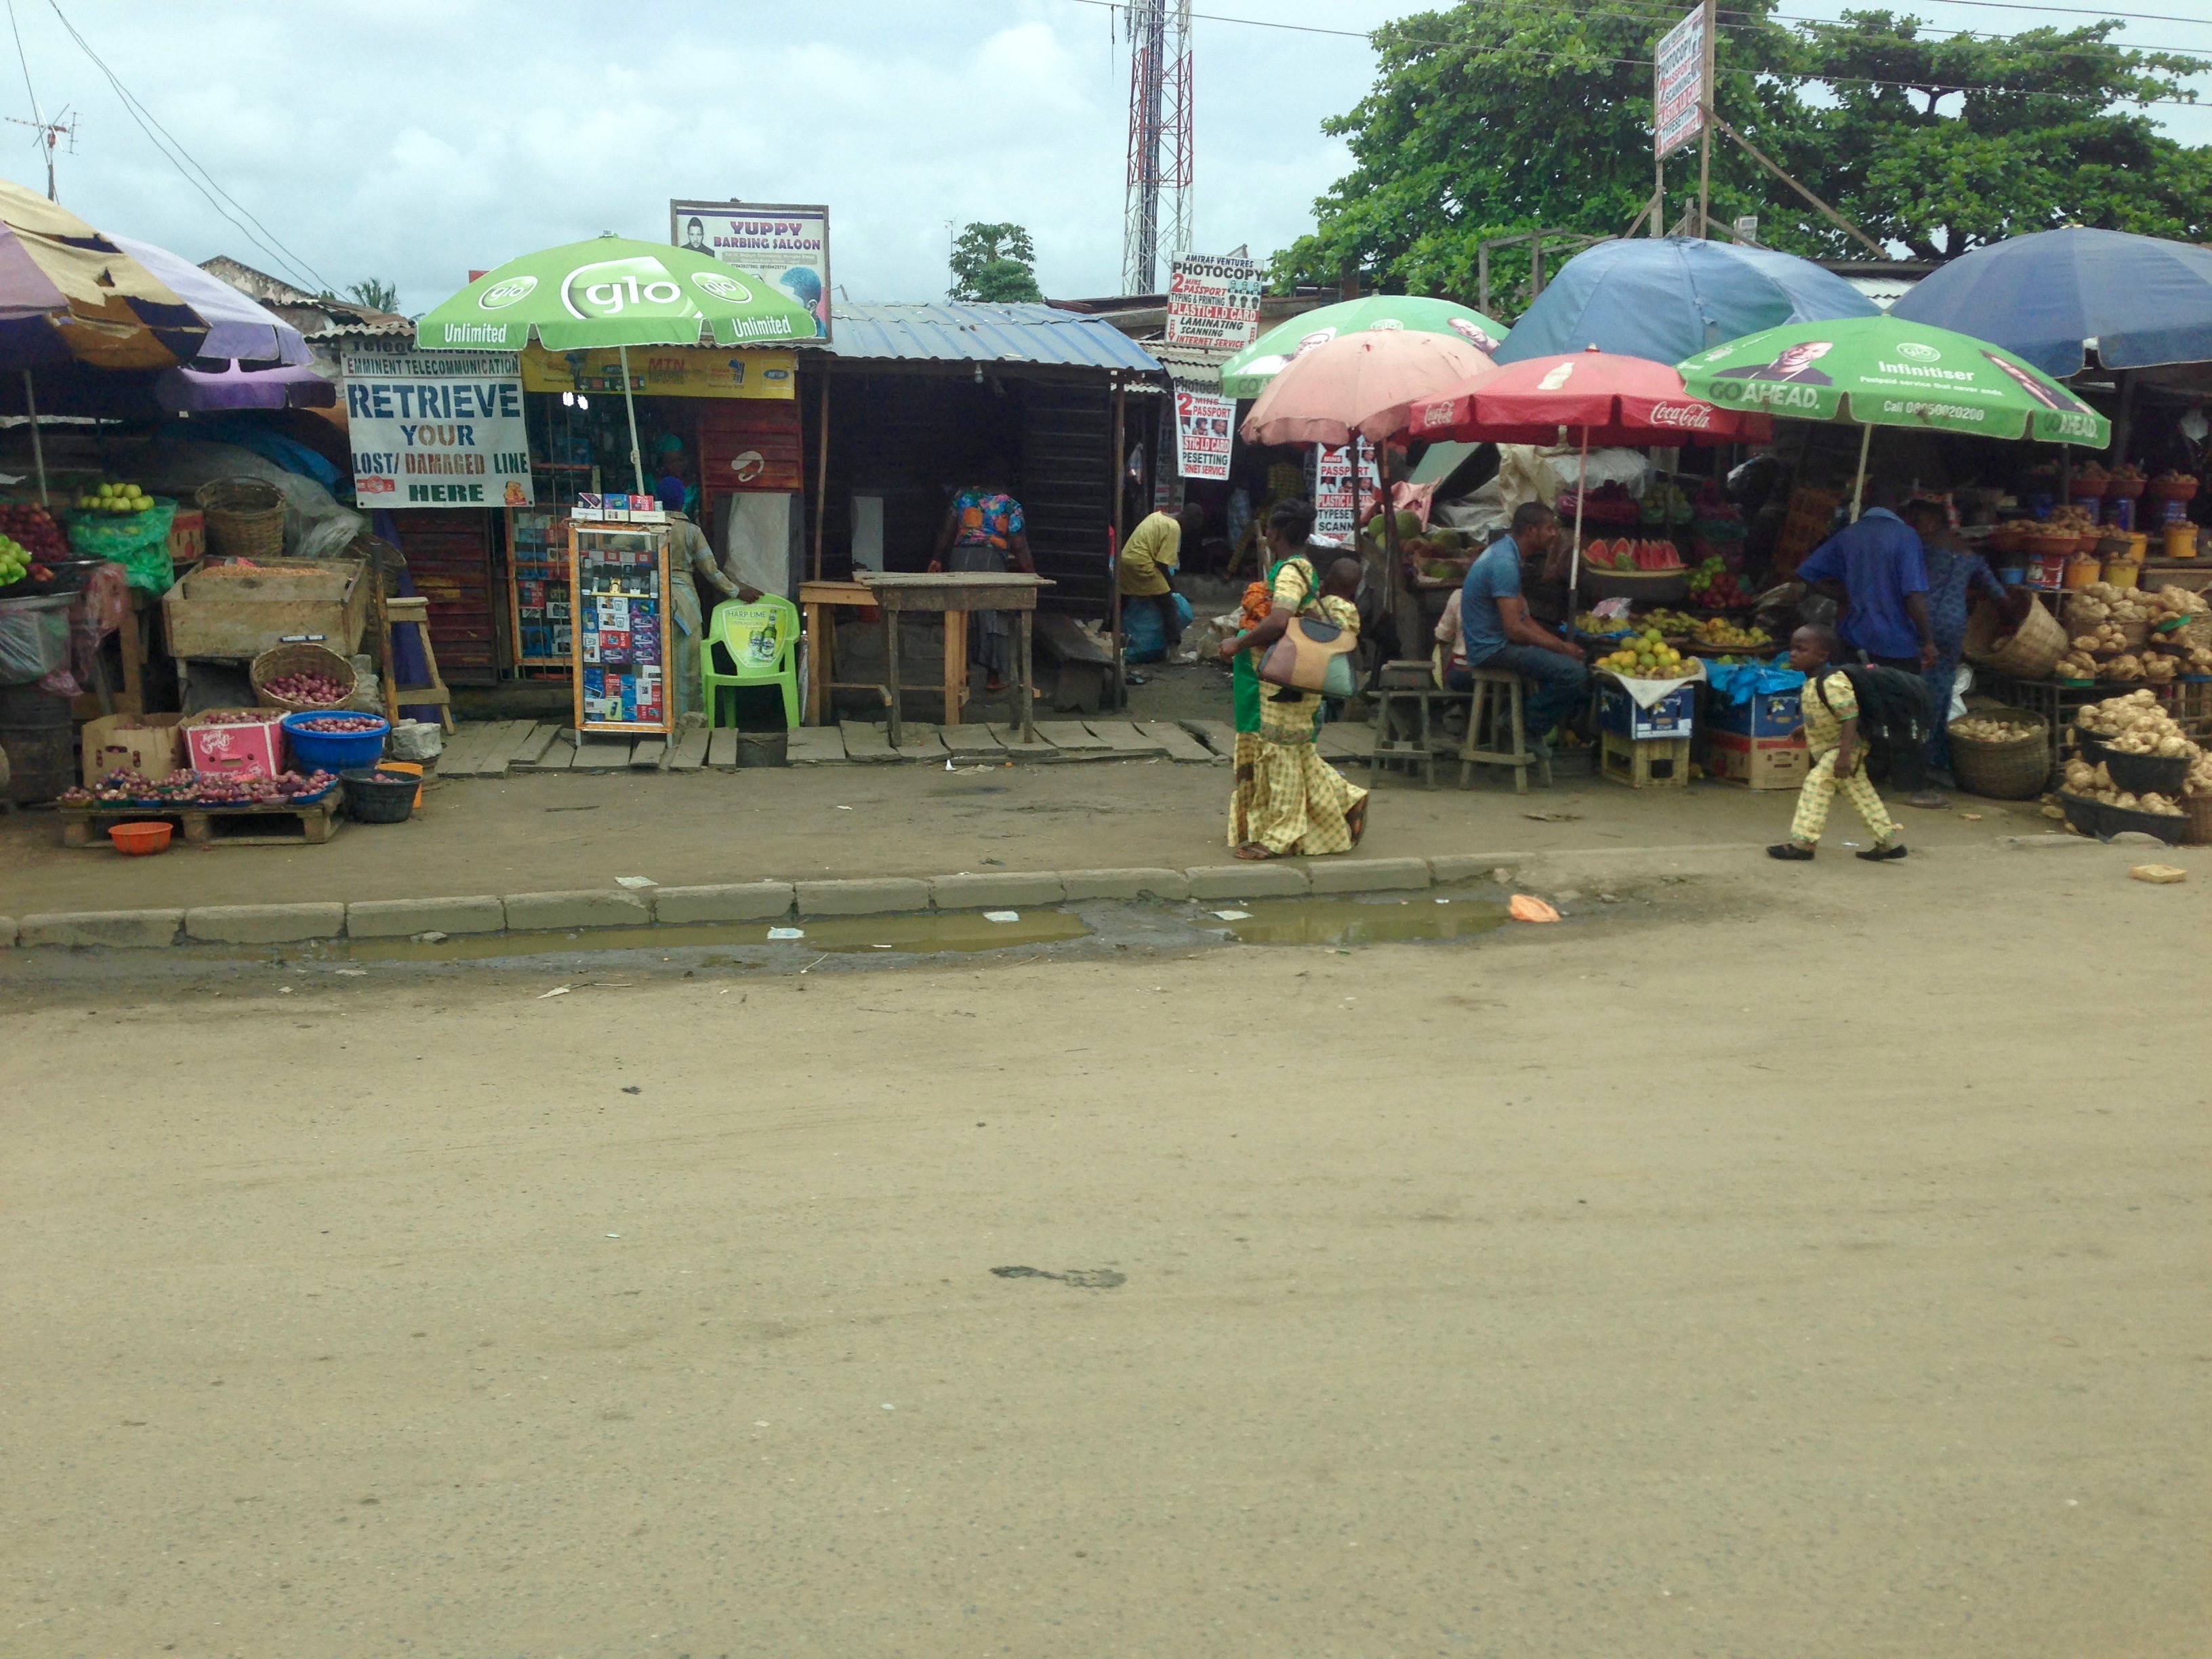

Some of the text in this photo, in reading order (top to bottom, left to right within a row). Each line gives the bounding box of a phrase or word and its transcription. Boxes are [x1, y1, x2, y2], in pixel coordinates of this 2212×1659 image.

[731, 221, 802, 236] YUPPY
[714, 237, 821, 250] BARBING SALOON
[1186, 254, 1254, 268] AMIRAF VENTURES
[1172, 262, 1263, 281] PHOTOCOPY
[1171, 273, 1184, 293] 2
[1183, 285, 1227, 296] PASSPORT
[490, 285, 524, 300] glo
[586, 276, 680, 314] glo
[1171, 293, 1191, 303] TYPING
[1198, 296, 1225, 306] PRINTING
[1172, 303, 1256, 321] PLASTIC I.D CARD
[732, 315, 792, 337] Unlimited
[1181, 316, 1244, 330] LAMINATING
[445, 323, 507, 343] Unlimited
[1181, 326, 1224, 337] SCANNING
[1176, 335, 1245, 348] INTERNET SERVICE
[347, 357, 519, 375] EMMINENT TELECOMMUNICATION
[649, 358, 685, 370] MTN
[1878, 361, 1975, 381] Infinitiser
[347, 384, 520, 419] RETRIEVE
[1177, 392, 1193, 415] 2
[1884, 401, 1903, 413] Call
[1193, 406, 1231, 418] PASSPORT
[400, 425, 475, 446] YOUR
[1184, 436, 1200, 450] STIC
[1211, 438, 1229, 452] CARD
[352, 452, 528, 474] LOST/ DAMAGED LINE
[1183, 451, 1228, 466] PESETTING
[1202, 465, 1226, 476] SERVICE
[1322, 466, 1370, 476] PASSPRT
[409, 484, 485, 501] HERE
[1319, 509, 1353, 519] TYPESET
[1319, 521, 1354, 531] SCANN
